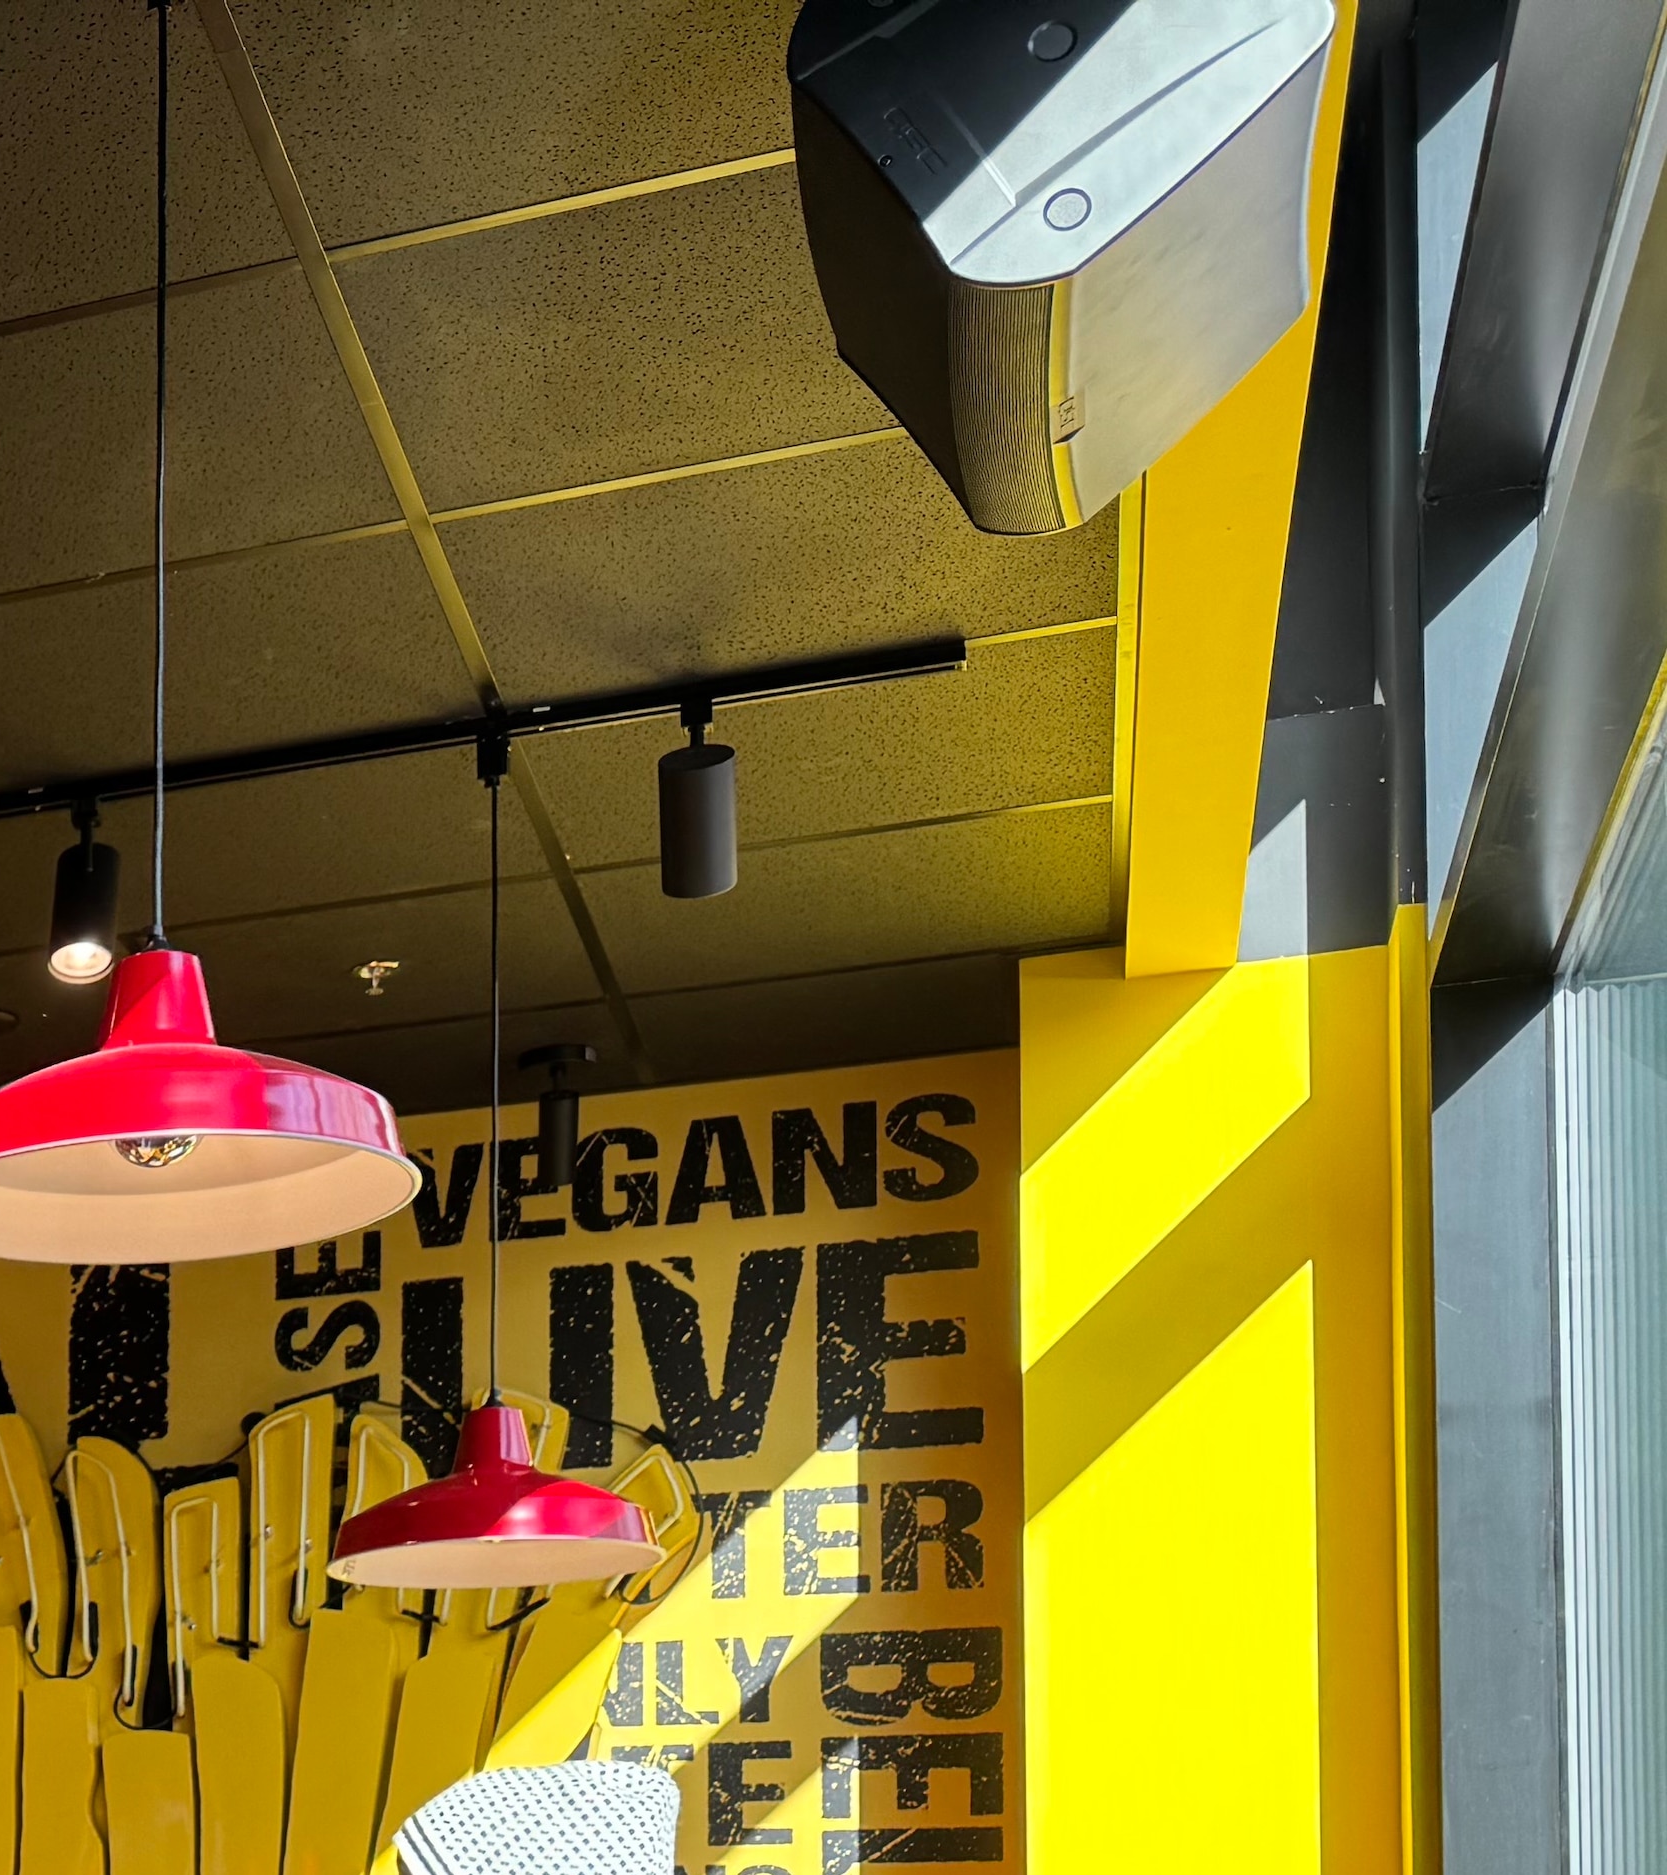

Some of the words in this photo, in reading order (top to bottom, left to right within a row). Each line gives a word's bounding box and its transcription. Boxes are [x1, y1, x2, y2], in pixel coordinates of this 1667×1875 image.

[417, 1092, 979, 1252] VEGANS
[398, 1228, 985, 1470] LIVE
[599, 1634, 794, 1728] NLY
